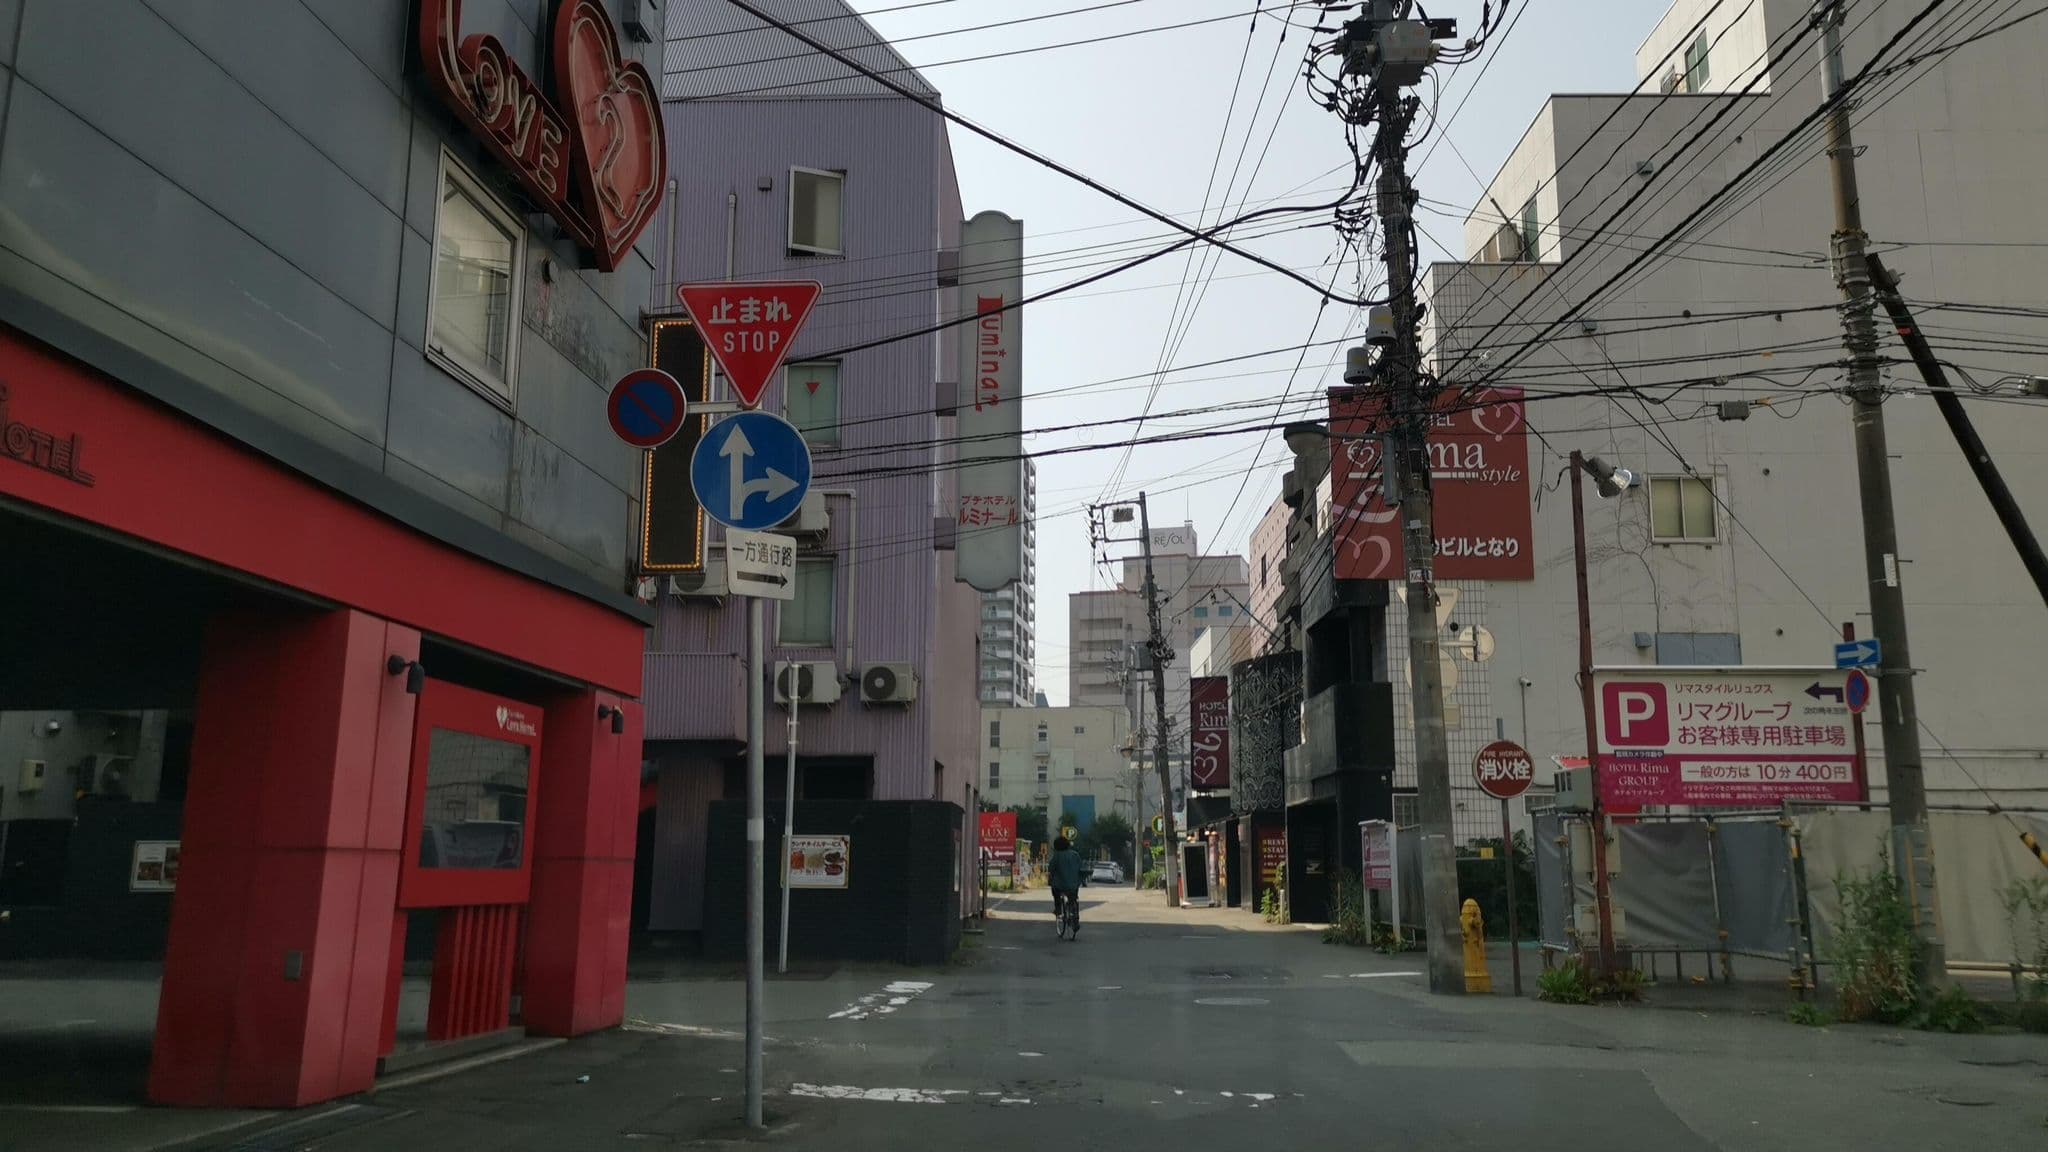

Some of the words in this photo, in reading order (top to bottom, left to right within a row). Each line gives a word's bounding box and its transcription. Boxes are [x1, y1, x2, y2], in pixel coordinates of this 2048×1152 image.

[708, 296, 792, 325] 止まれ
[723, 331, 780, 353] STOP
[1426, 442, 1487, 469] ma
[1481, 466, 1520, 485] style
[958, 507, 1018, 527] ルミナール
[1153, 532, 1185, 548] RESOL
[732, 541, 793, 567] 一方通行路
[1675, 683, 1774, 694] リマスタイルリュクス
[1618, 691, 1656, 738] P
[1678, 701, 1793, 722] リマグループ
[1678, 725, 1847, 747] お客様専用駐車場
[1479, 758, 1531, 781] 消火栓
[1608, 763, 1639, 773] HOTEL
[1640, 762, 1670, 774] Rima
[1687, 766, 1750, 779] 一般の方は
[1618, 775, 1659, 786] GROUP
[981, 827, 1010, 838] LUXE
[978, 846, 994, 860] IN
